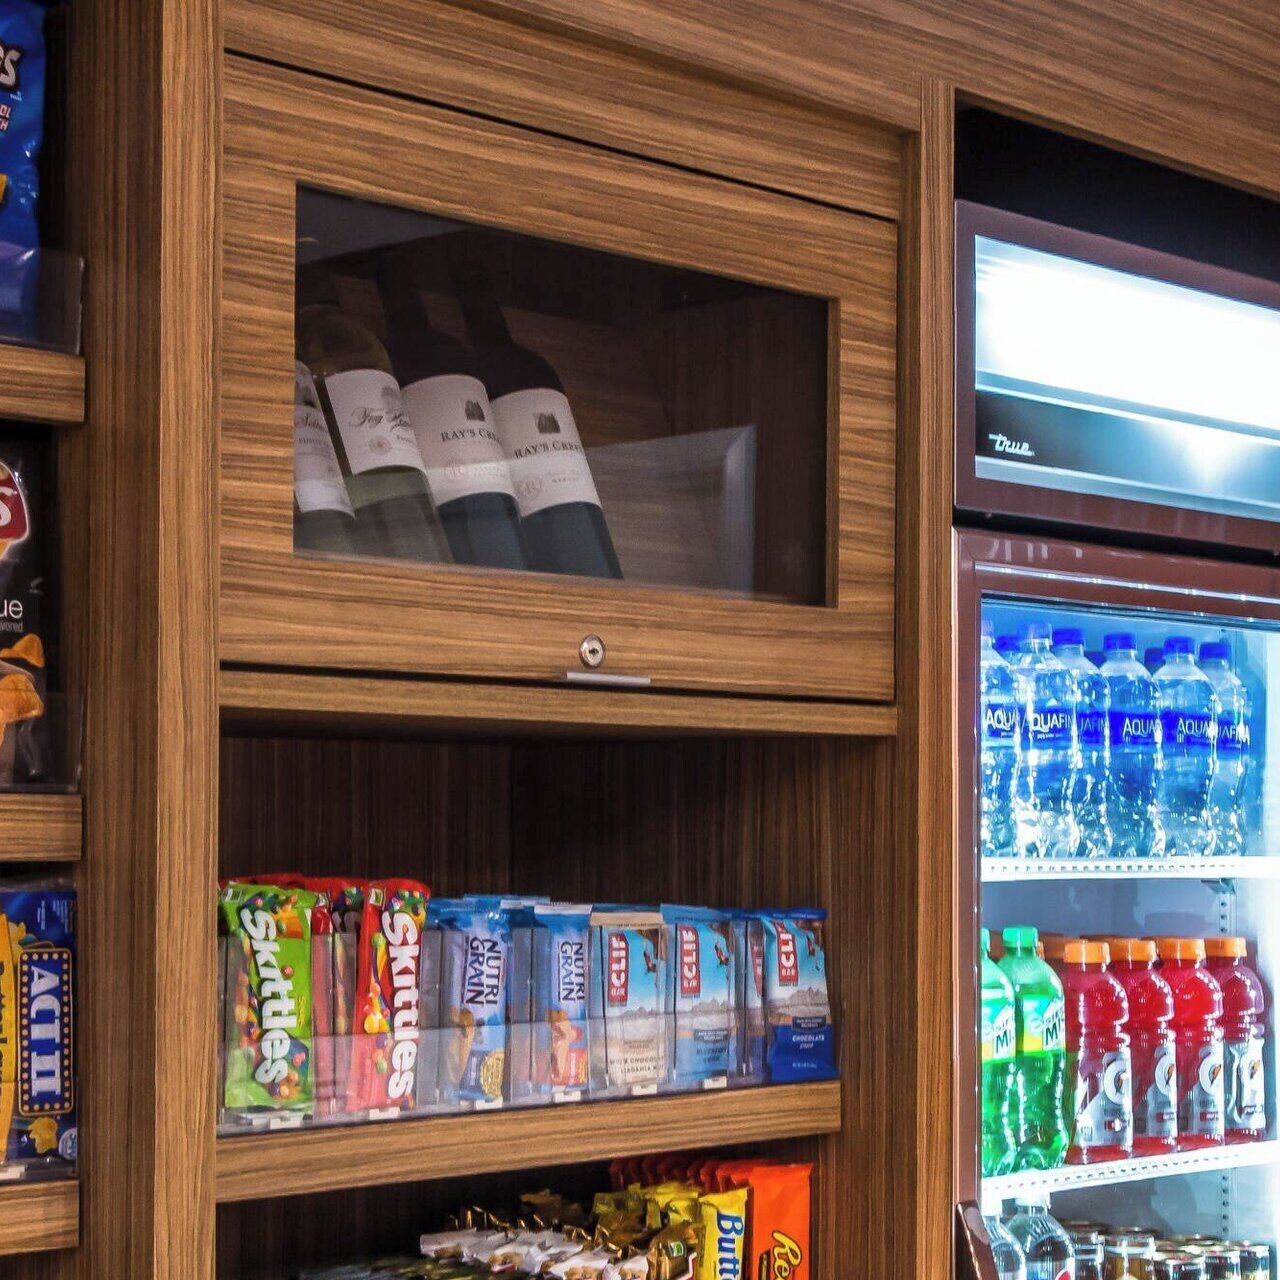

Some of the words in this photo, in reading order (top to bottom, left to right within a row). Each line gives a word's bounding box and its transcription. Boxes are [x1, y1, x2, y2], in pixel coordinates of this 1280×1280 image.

[466, 935, 486, 1007] GRAIN
[484, 937, 503, 1006] NUTRI
[558, 940, 576, 1004] GRAIN
[572, 941, 586, 1003] NUTRI
[611, 937, 627, 987] CLIF
[682, 928, 697, 979] CLIF
[30, 965, 62, 1044] ACT
[240, 908, 298, 1085] Skittles
[381, 910, 420, 1100] Skittles
